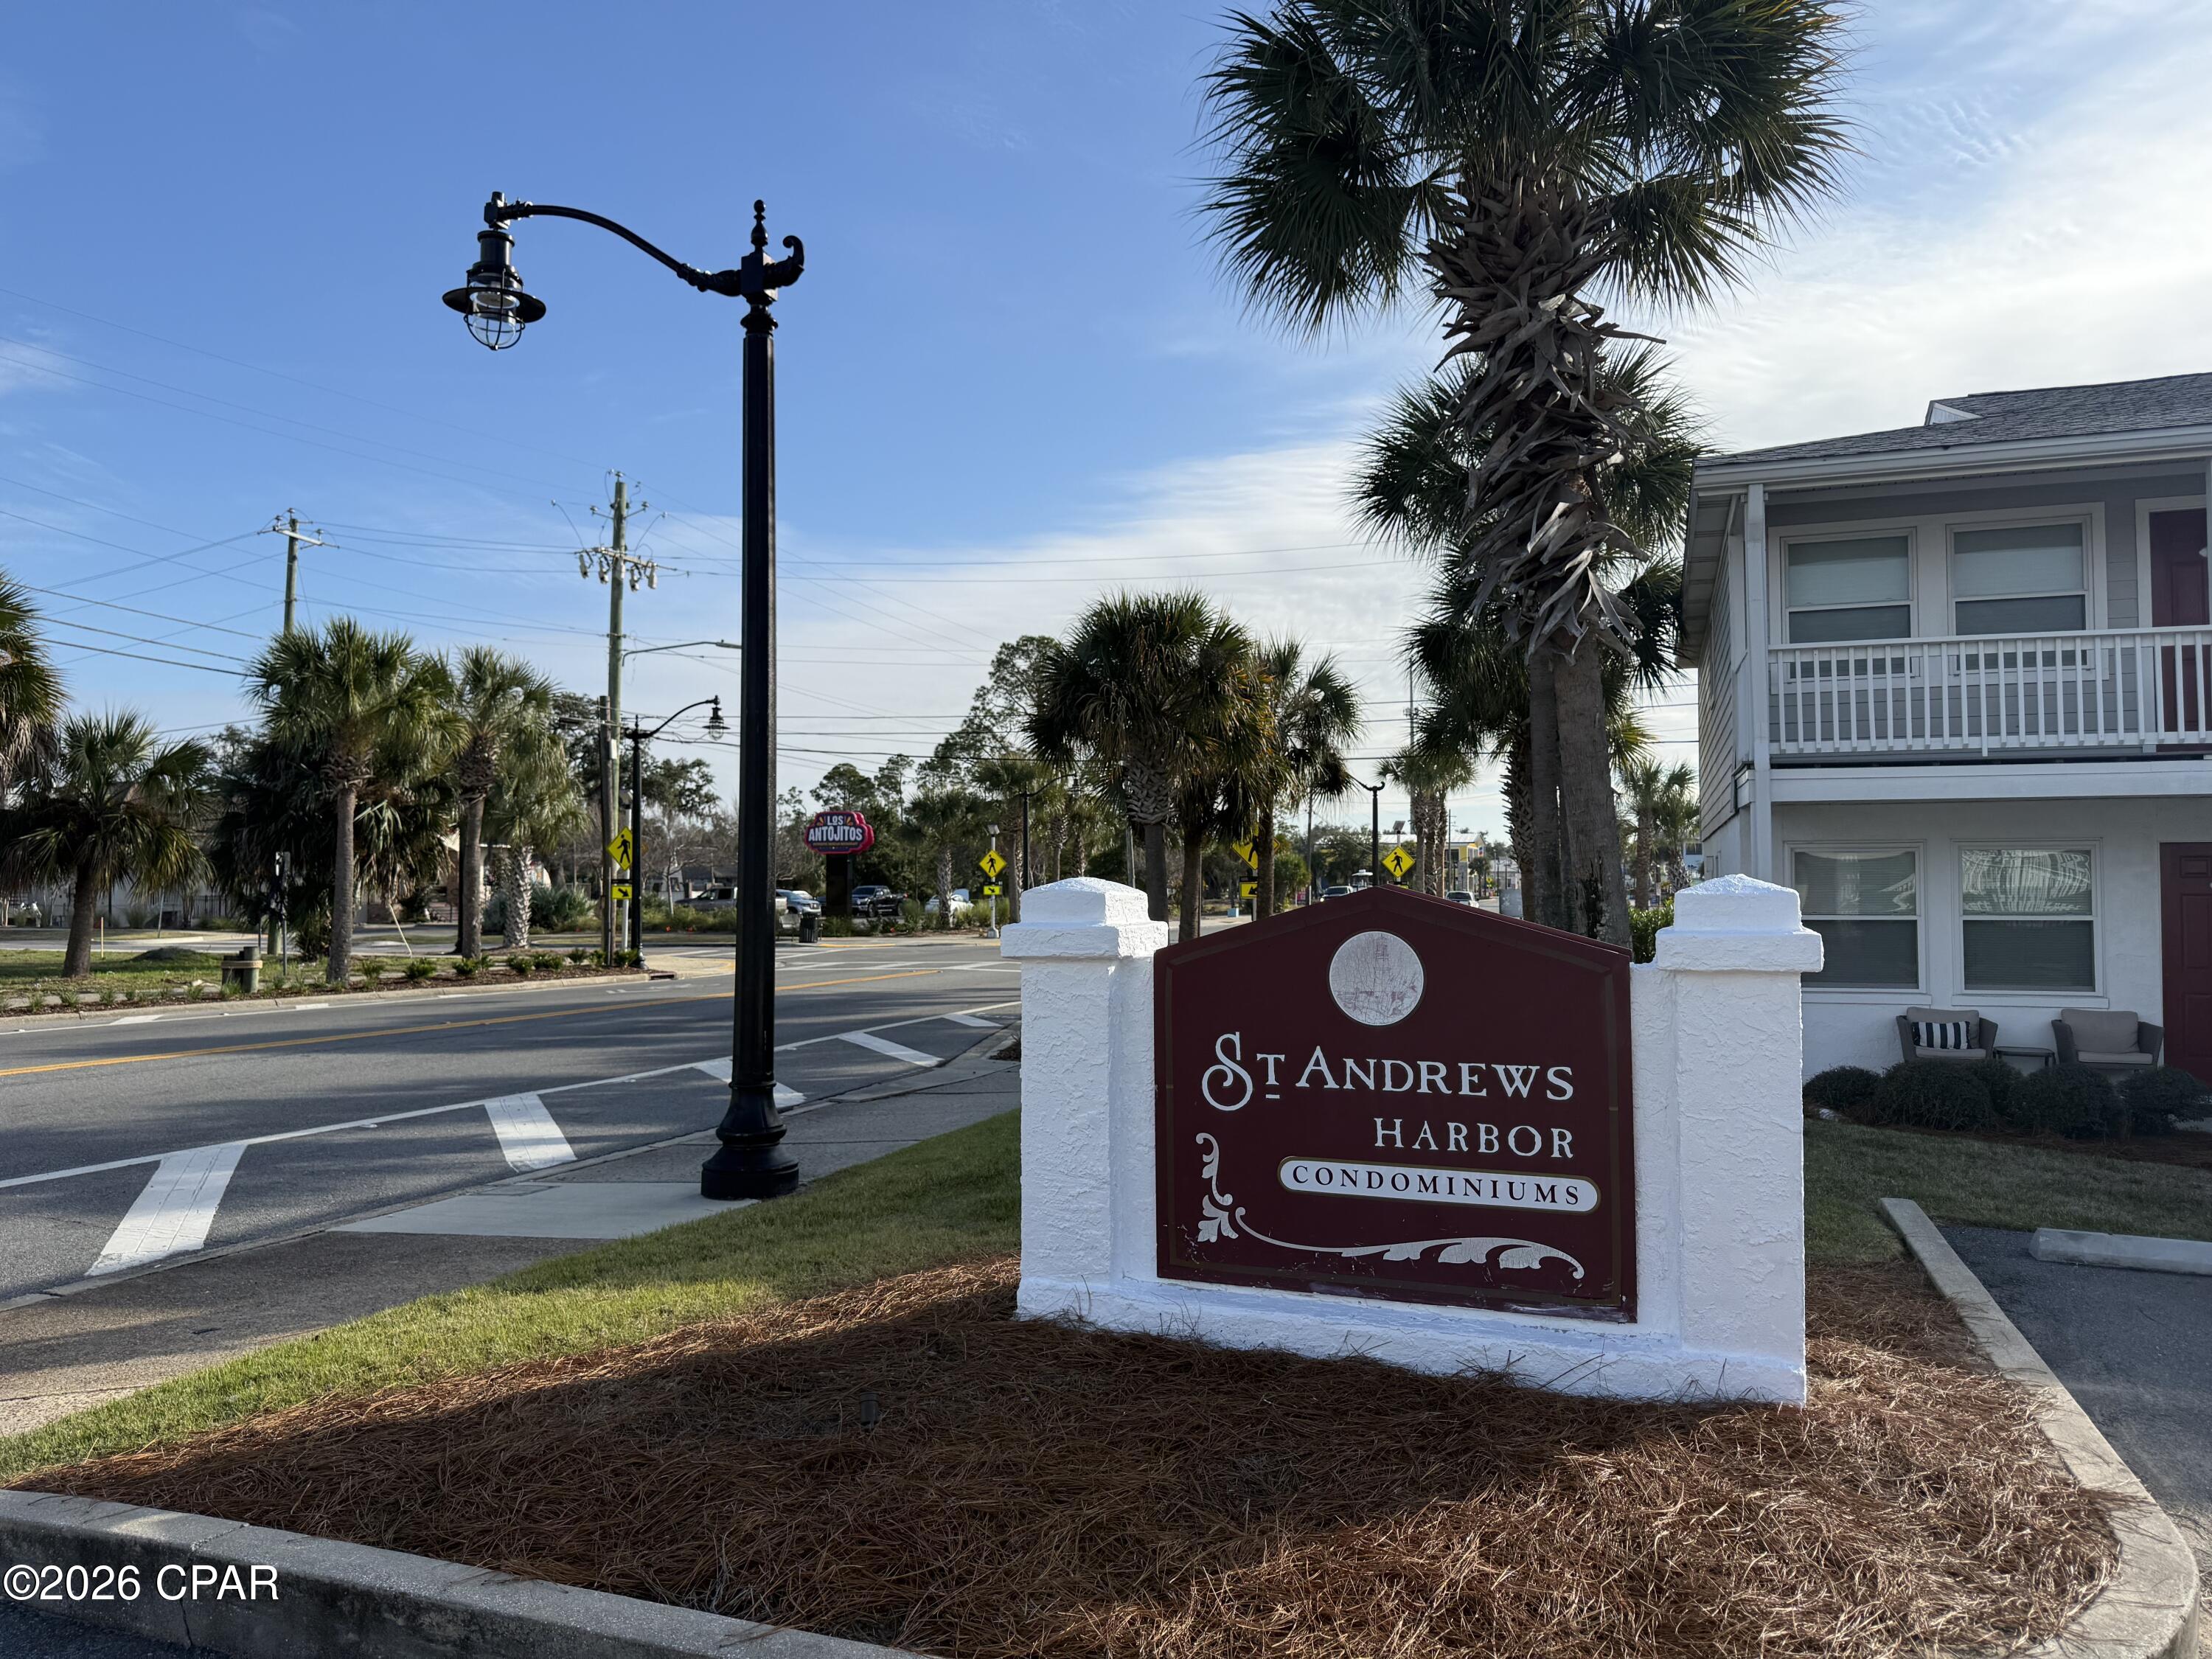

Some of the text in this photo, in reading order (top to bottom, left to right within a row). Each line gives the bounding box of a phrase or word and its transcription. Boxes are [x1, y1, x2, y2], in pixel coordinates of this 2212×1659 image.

[808, 826, 863, 841] ANTOJITOS
[827, 815, 844, 825] LOS
[1295, 1046, 1573, 1101] ANDREWS
[1374, 1118, 1573, 1158] HARBOR
[1293, 1165, 1579, 1206] CONDOMINIUMS
